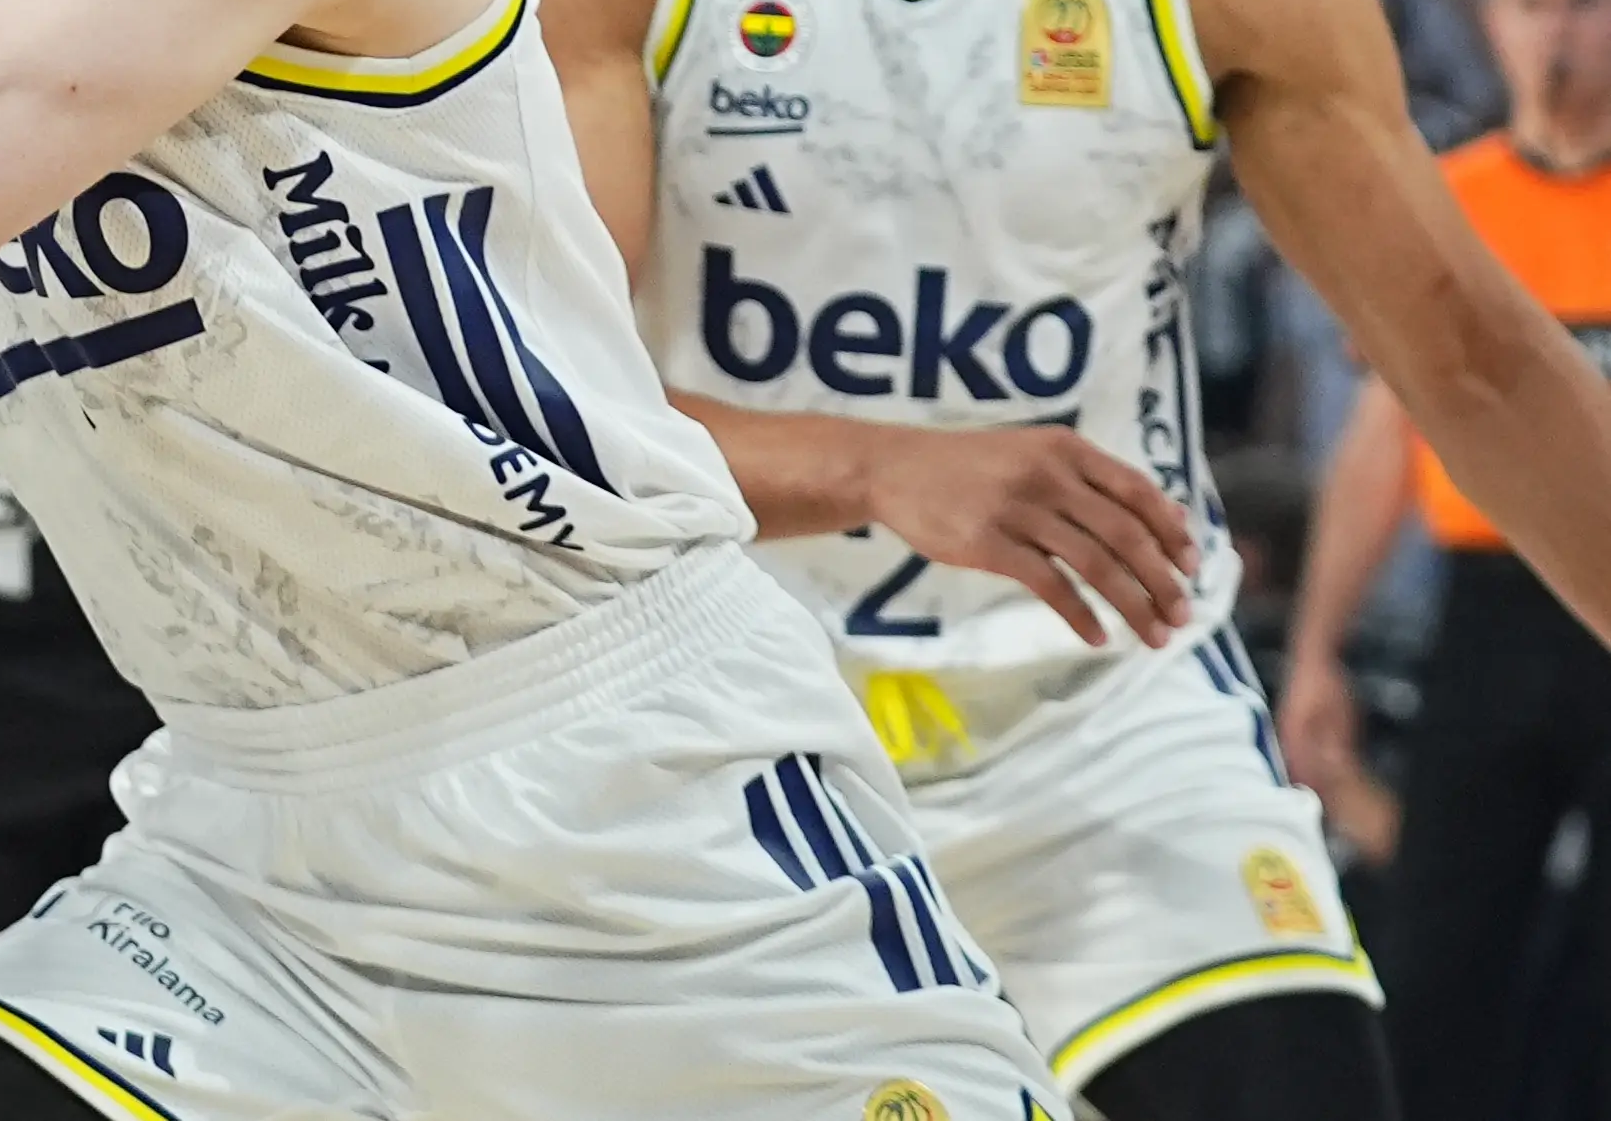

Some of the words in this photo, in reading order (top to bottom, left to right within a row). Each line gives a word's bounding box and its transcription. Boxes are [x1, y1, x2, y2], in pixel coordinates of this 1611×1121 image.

[709, 80, 810, 120] beko
[262, 149, 388, 335] Milk
[699, 241, 1094, 401] beko
[88, 920, 226, 1026] Kiralama
